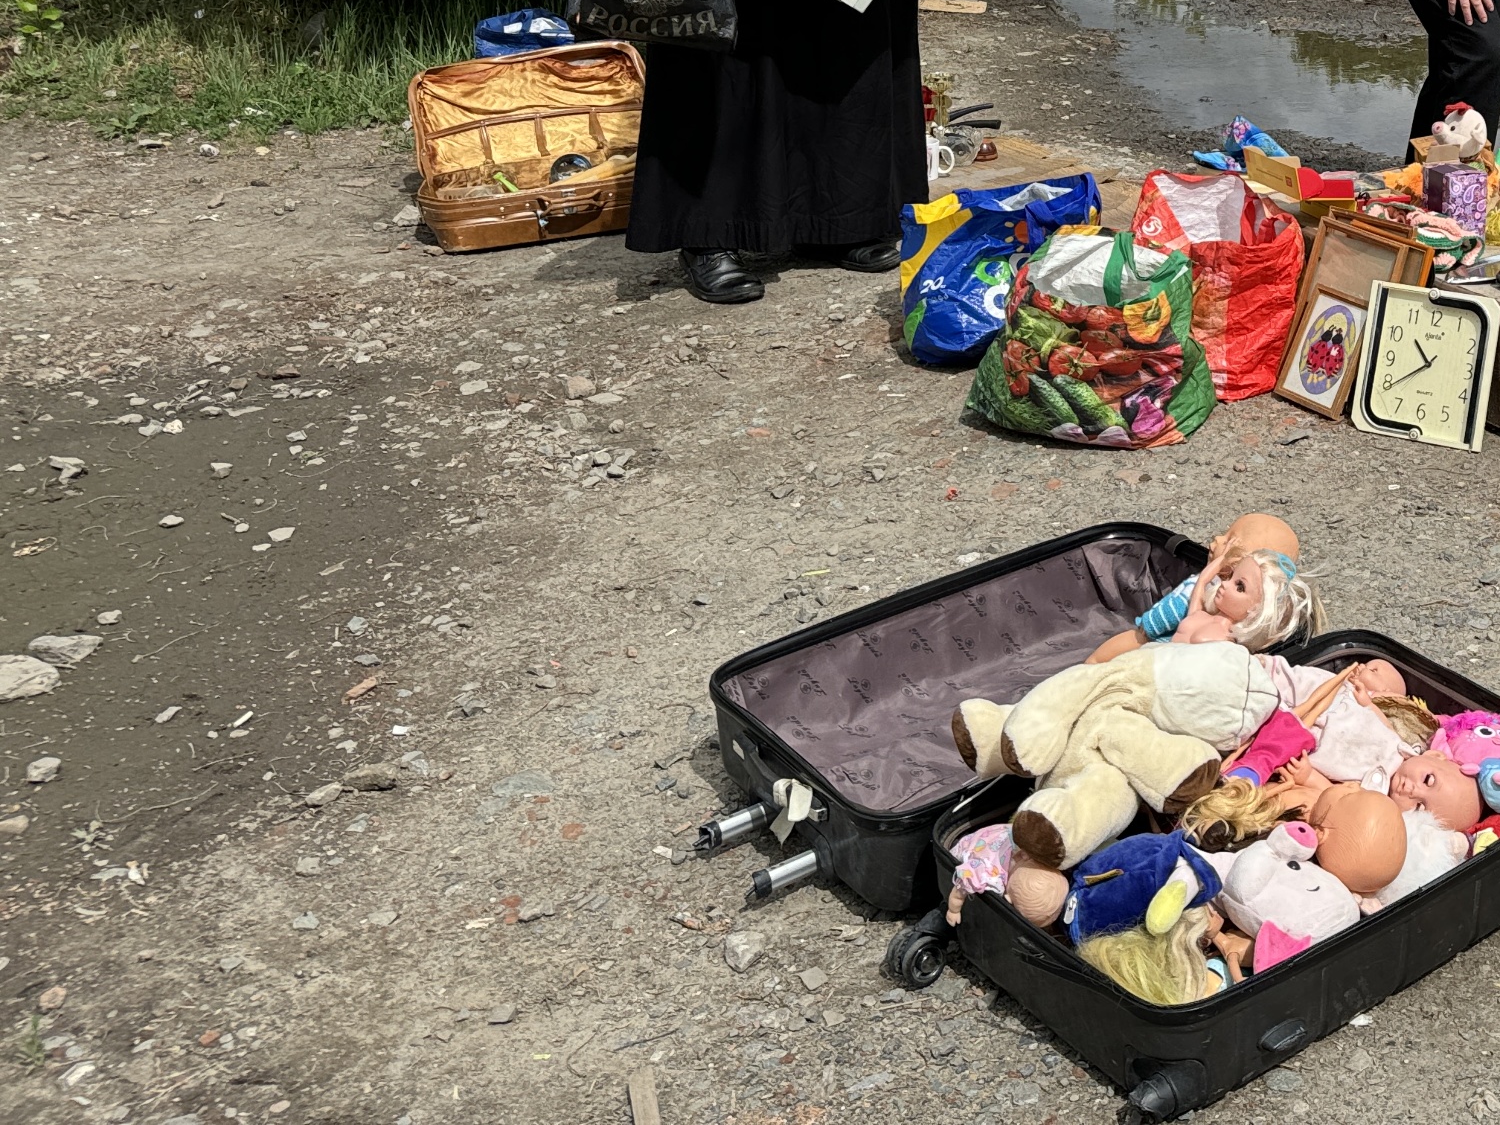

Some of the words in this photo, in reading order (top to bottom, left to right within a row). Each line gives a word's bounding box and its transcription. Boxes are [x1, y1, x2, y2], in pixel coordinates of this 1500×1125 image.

[586, 2, 719, 38] РОССИЯ
[1408, 308, 1420, 325] 11
[1431, 310, 1443, 328] 12
[1456, 315, 1463, 333] 1
[1388, 324, 1403, 343] 10
[1466, 338, 1476, 356] 2
[1385, 349, 1396, 367] 9
[1463, 362, 1473, 381] 3
[1382, 373, 1393, 391] 8
[1394, 396, 1404, 415] 7
[1457, 388, 1468, 405] 4
[1416, 402, 1426, 421] 6
[1439, 405, 1450, 423] 5
